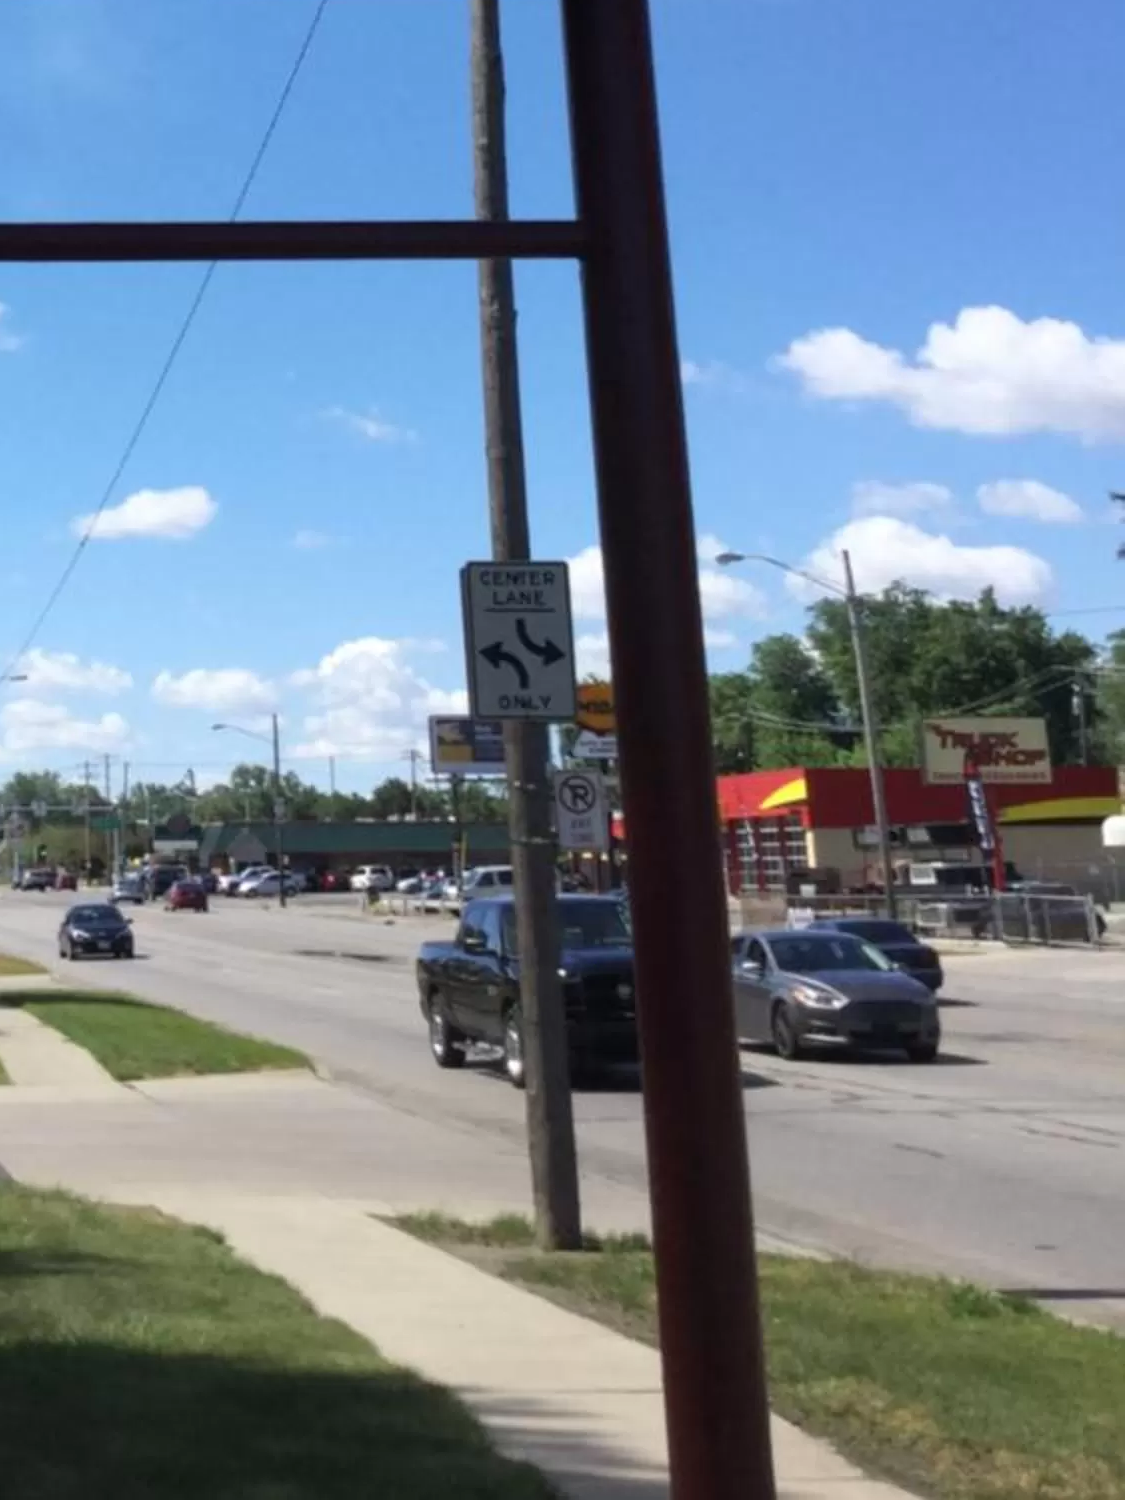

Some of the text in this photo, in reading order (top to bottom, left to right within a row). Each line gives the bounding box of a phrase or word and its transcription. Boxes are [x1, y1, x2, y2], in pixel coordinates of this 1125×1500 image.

[479, 570, 556, 586] CENTER
[492, 589, 547, 606] LANE
[498, 694, 553, 711] ONLY
